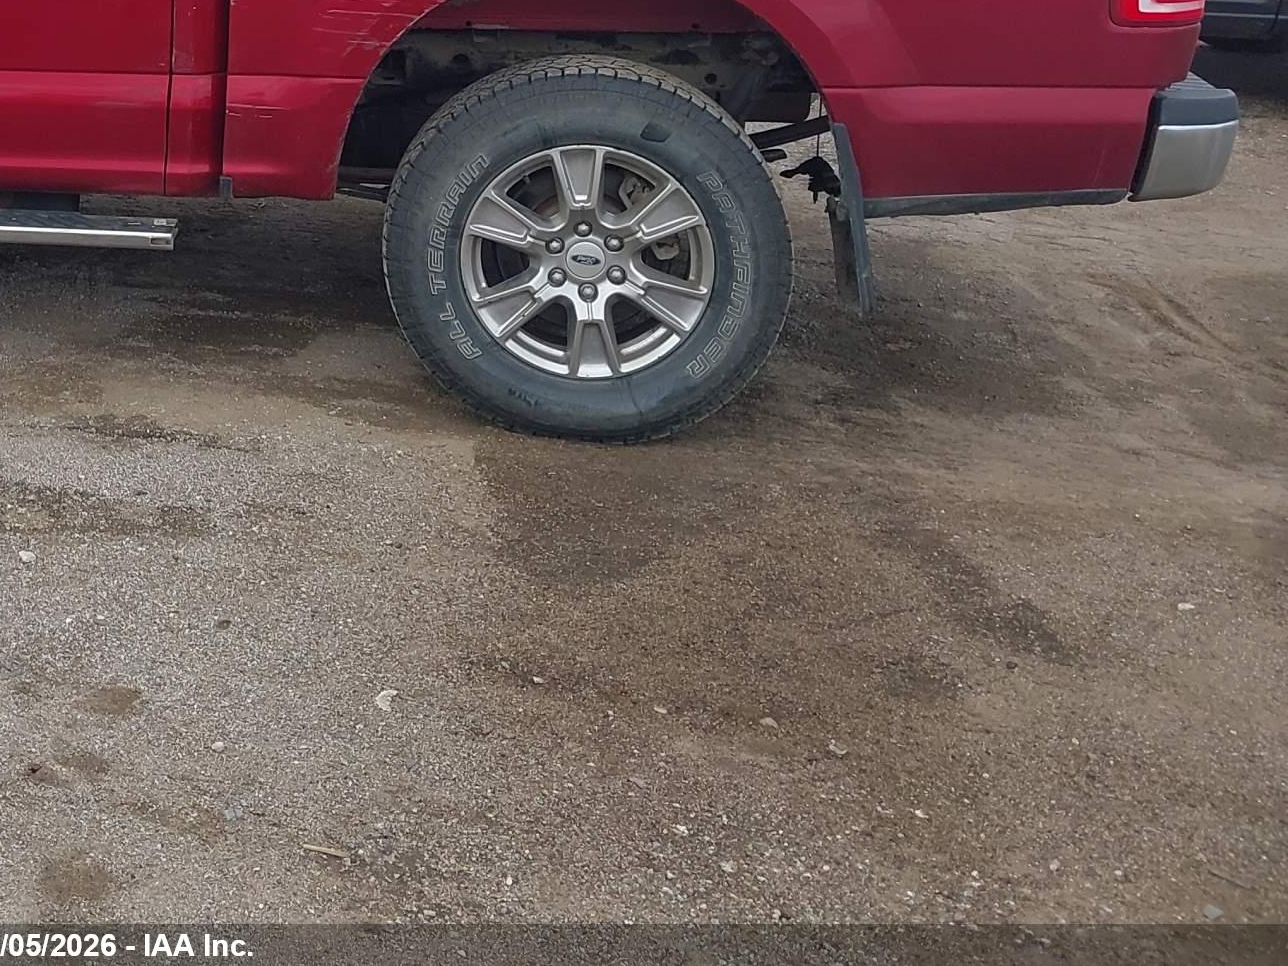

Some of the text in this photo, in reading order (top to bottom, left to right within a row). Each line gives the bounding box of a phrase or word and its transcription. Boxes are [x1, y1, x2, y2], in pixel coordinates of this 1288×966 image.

[427, 153, 489, 360] ALL TERRAIN
[686, 170, 752, 379] PATHFINDER
